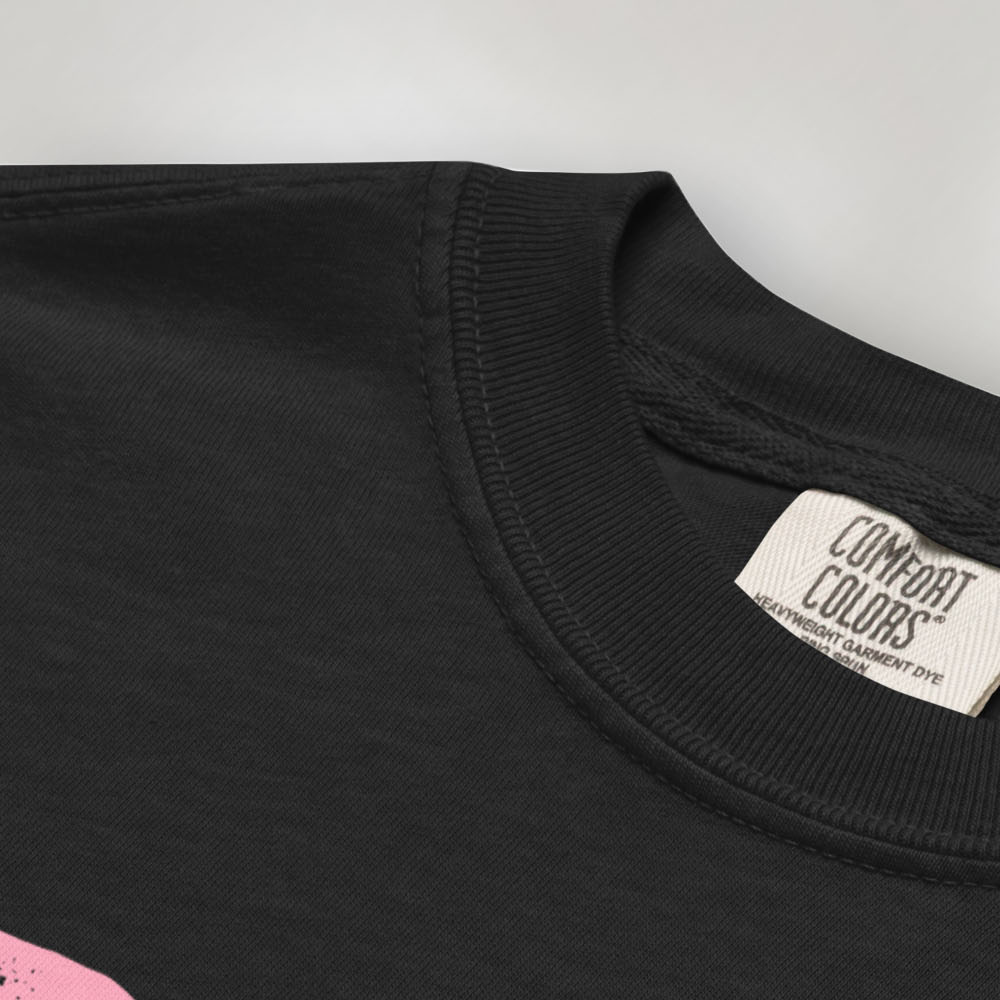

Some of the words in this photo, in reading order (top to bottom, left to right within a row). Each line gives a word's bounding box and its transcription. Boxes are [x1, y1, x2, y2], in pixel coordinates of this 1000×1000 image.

[829, 514, 978, 612] COMFORT
[753, 592, 843, 644] HEAVYWEIGHT
[842, 639, 914, 673] GARMENT
[912, 666, 945, 685] DYE
